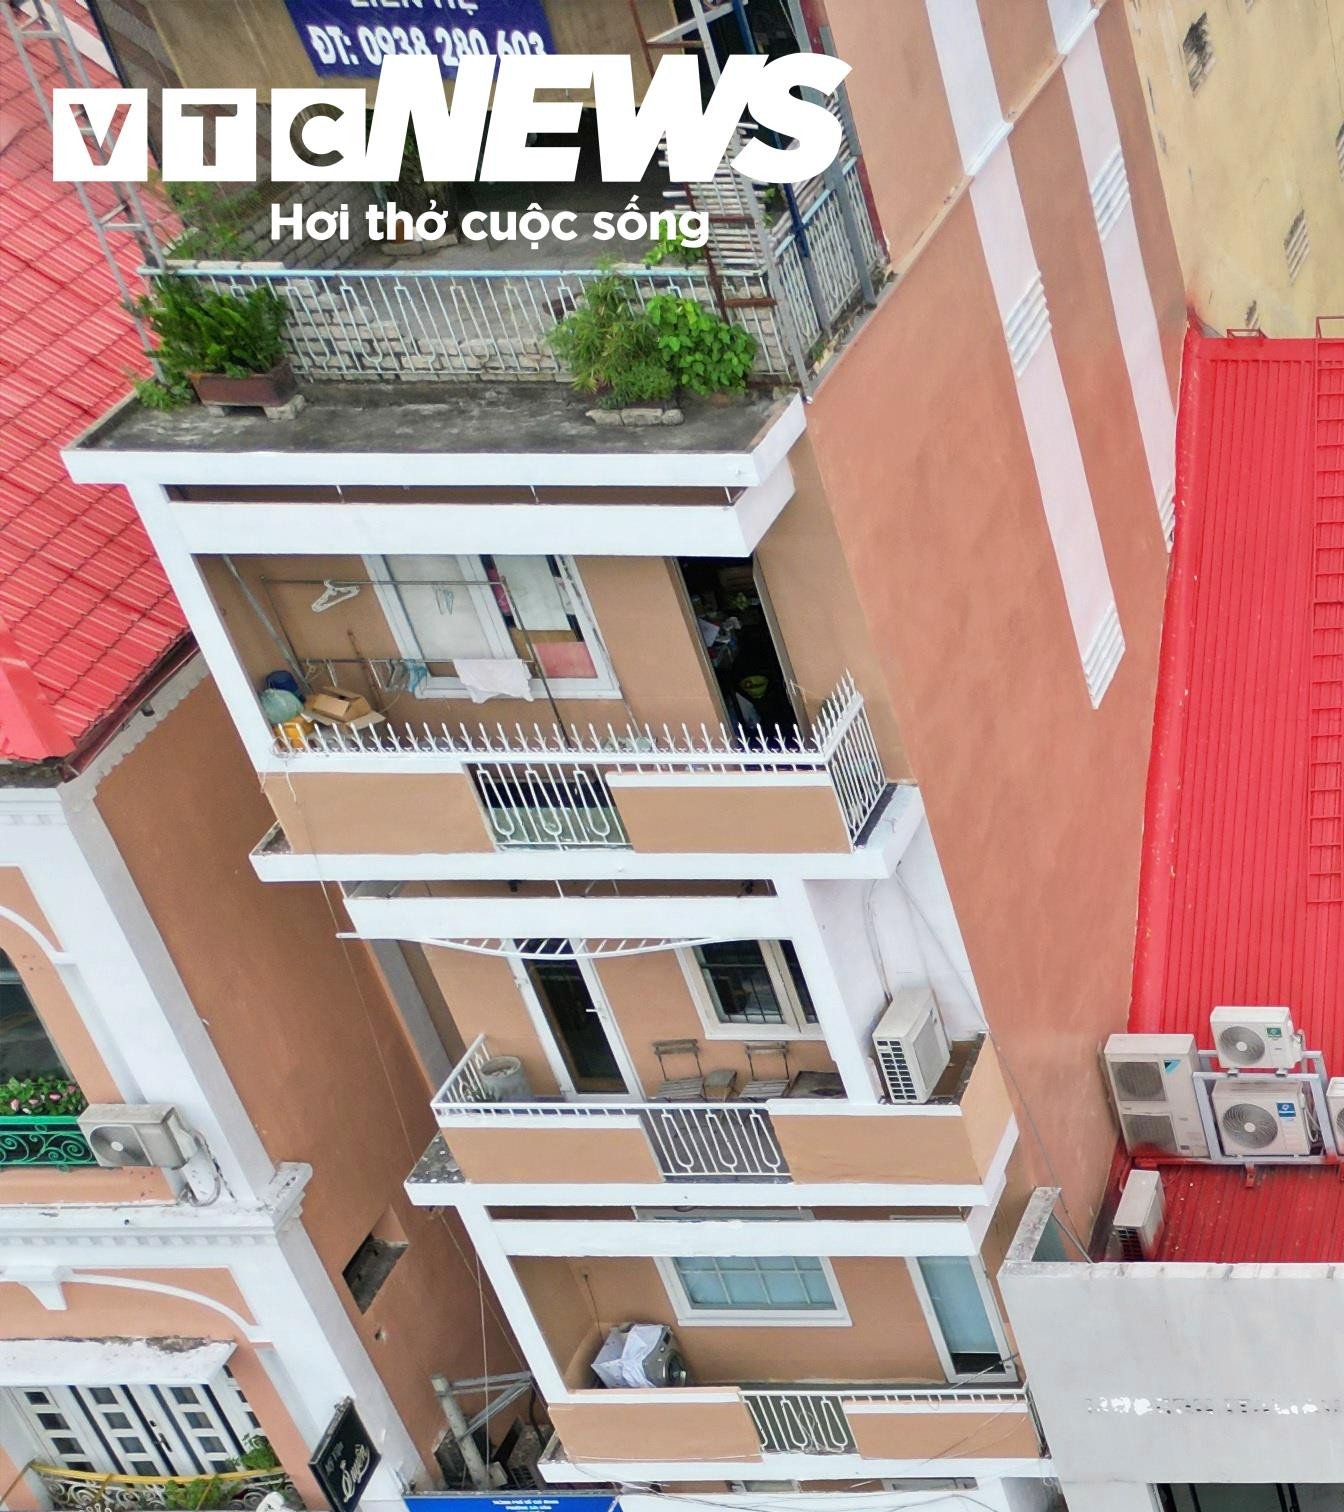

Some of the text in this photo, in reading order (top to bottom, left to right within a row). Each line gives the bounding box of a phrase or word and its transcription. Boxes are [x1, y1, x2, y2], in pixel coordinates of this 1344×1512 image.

[307, 25, 359, 65] ĐT:
[357, 26, 432, 66] 0938
[434, 27, 489, 66] 280
